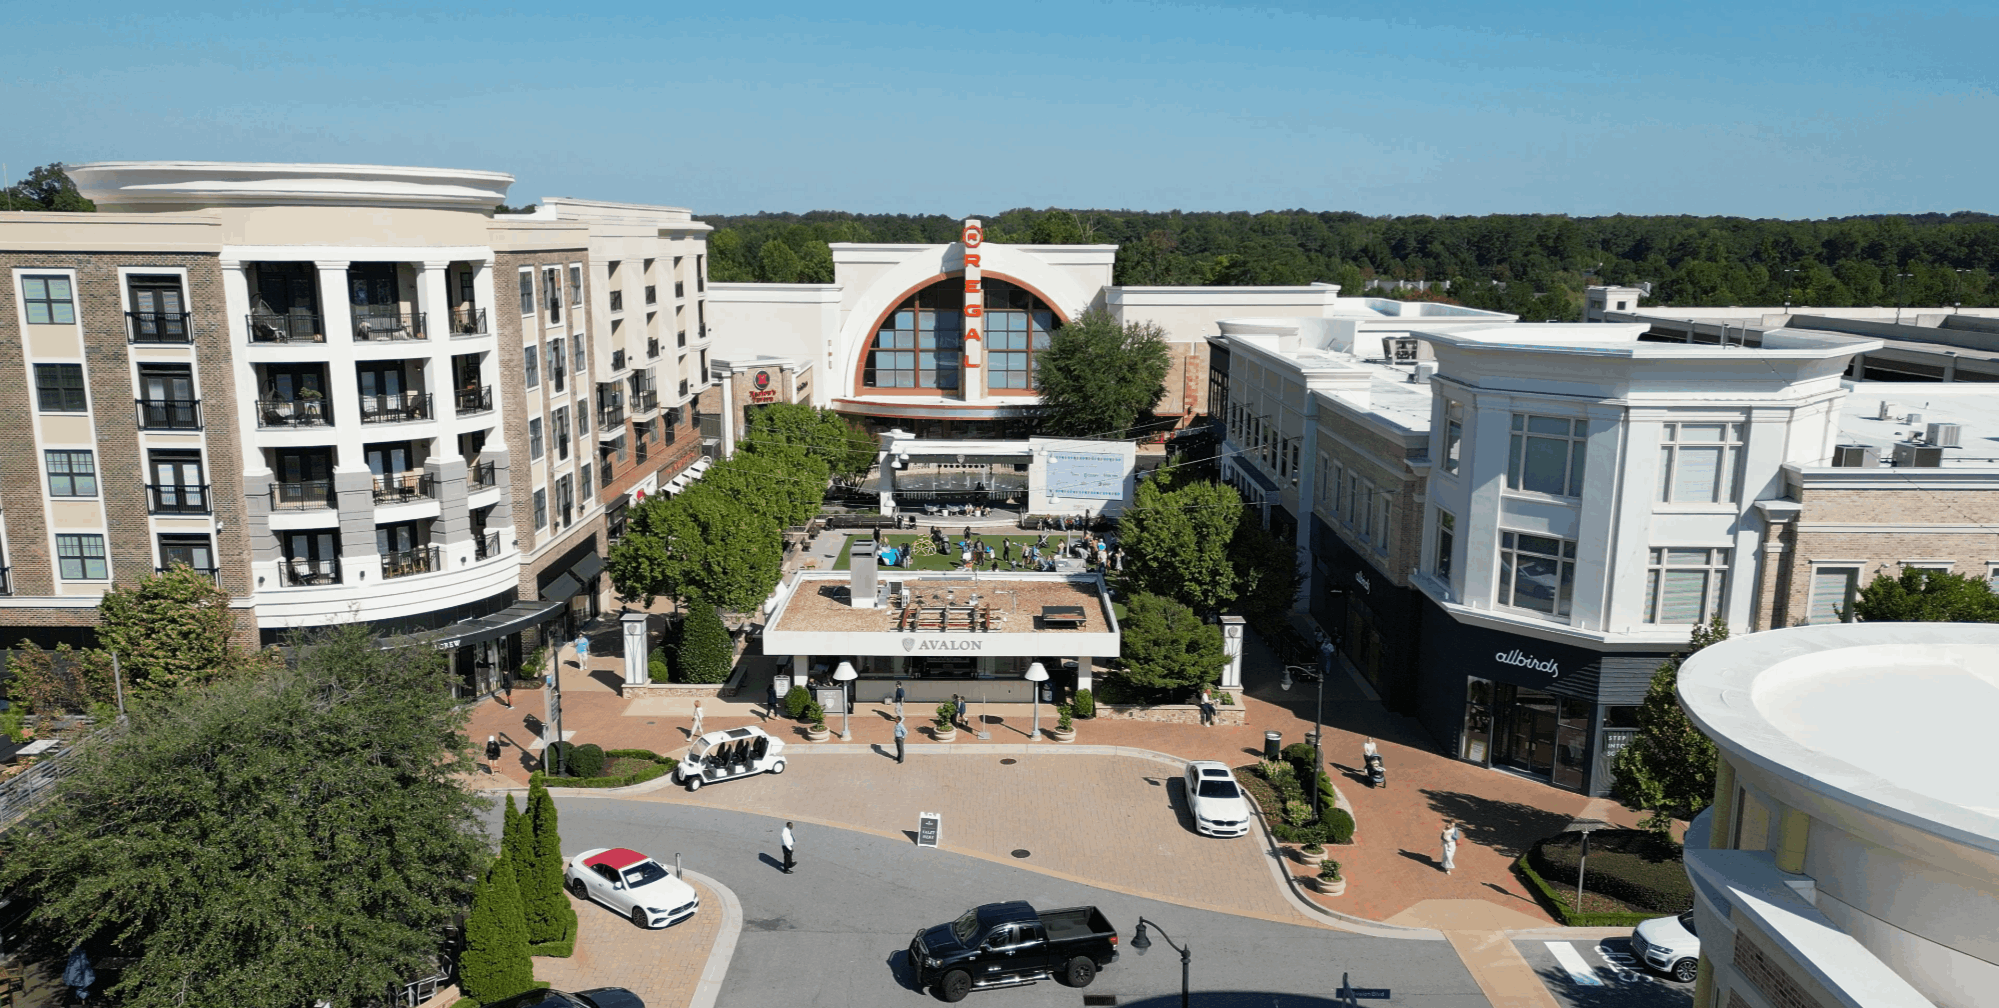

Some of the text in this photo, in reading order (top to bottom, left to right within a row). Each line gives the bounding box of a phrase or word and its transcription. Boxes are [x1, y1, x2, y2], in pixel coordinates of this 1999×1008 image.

[964, 254, 981, 368] REGAL
[918, 640, 983, 650] AVALON
[1495, 649, 1559, 678] allbirds
